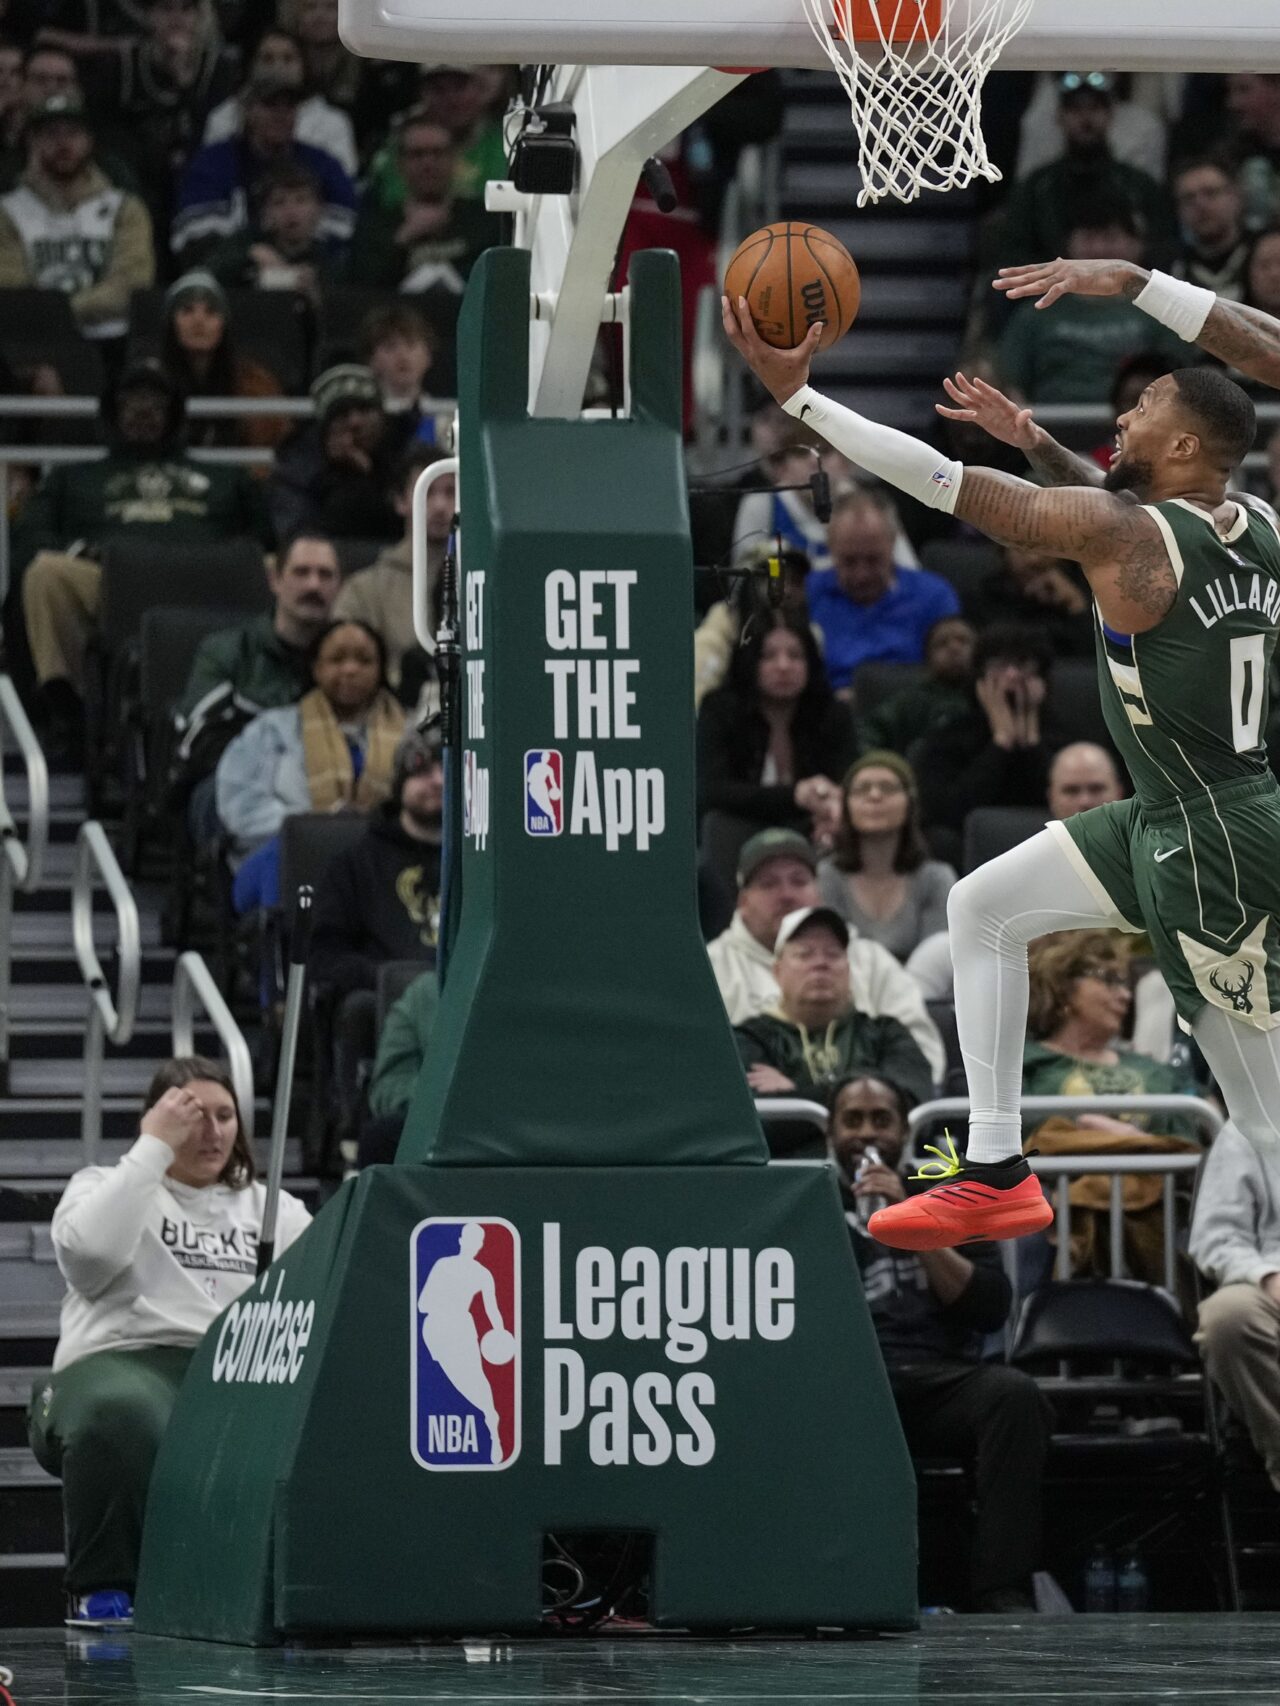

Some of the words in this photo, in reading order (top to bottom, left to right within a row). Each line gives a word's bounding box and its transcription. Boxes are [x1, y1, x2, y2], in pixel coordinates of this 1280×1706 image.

[466, 570, 485, 651] GET
[544, 569, 638, 650] GET
[466, 659, 485, 739] THE
[544, 659, 641, 739] THE
[1229, 633, 1265, 753] 0
[530, 815, 549, 831] NBA
[570, 750, 665, 851] App
[161, 1216, 258, 1260] BUCKS
[212, 1268, 316, 1384] coinbase
[543, 1222, 795, 1364] League
[428, 1414, 479, 1454] NBA
[543, 1347, 716, 1466] Pass
